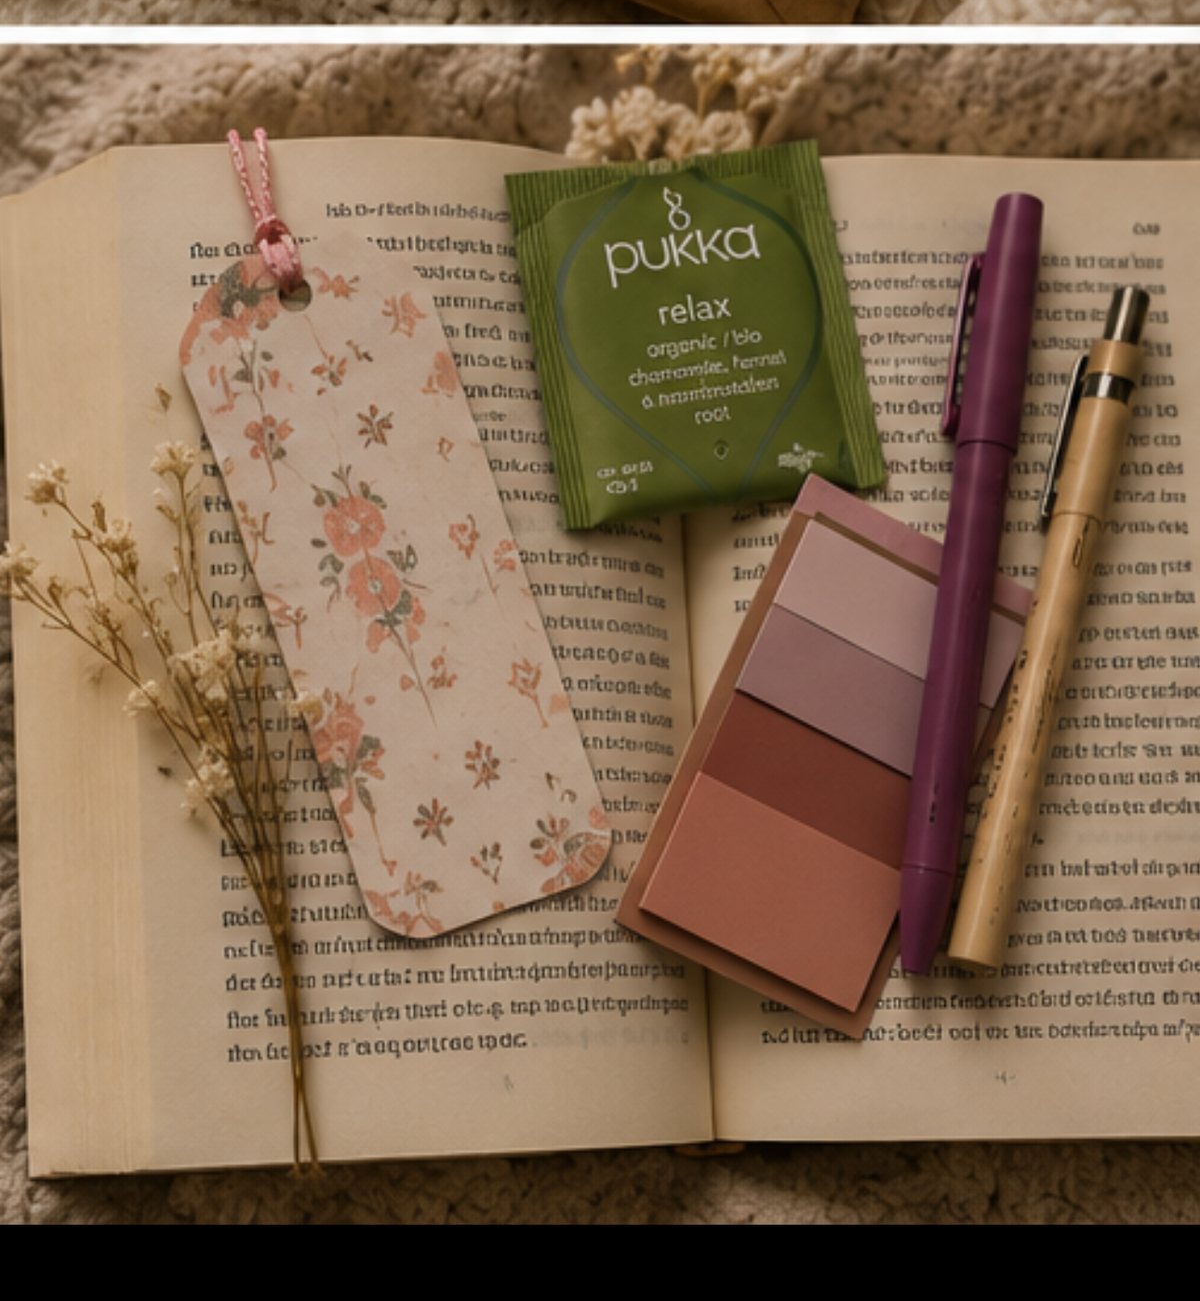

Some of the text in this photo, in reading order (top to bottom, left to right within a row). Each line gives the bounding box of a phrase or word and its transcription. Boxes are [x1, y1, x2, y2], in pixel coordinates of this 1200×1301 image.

[604, 223, 761, 289] pukka
[658, 294, 732, 326] relax
[646, 333, 717, 359] organic
